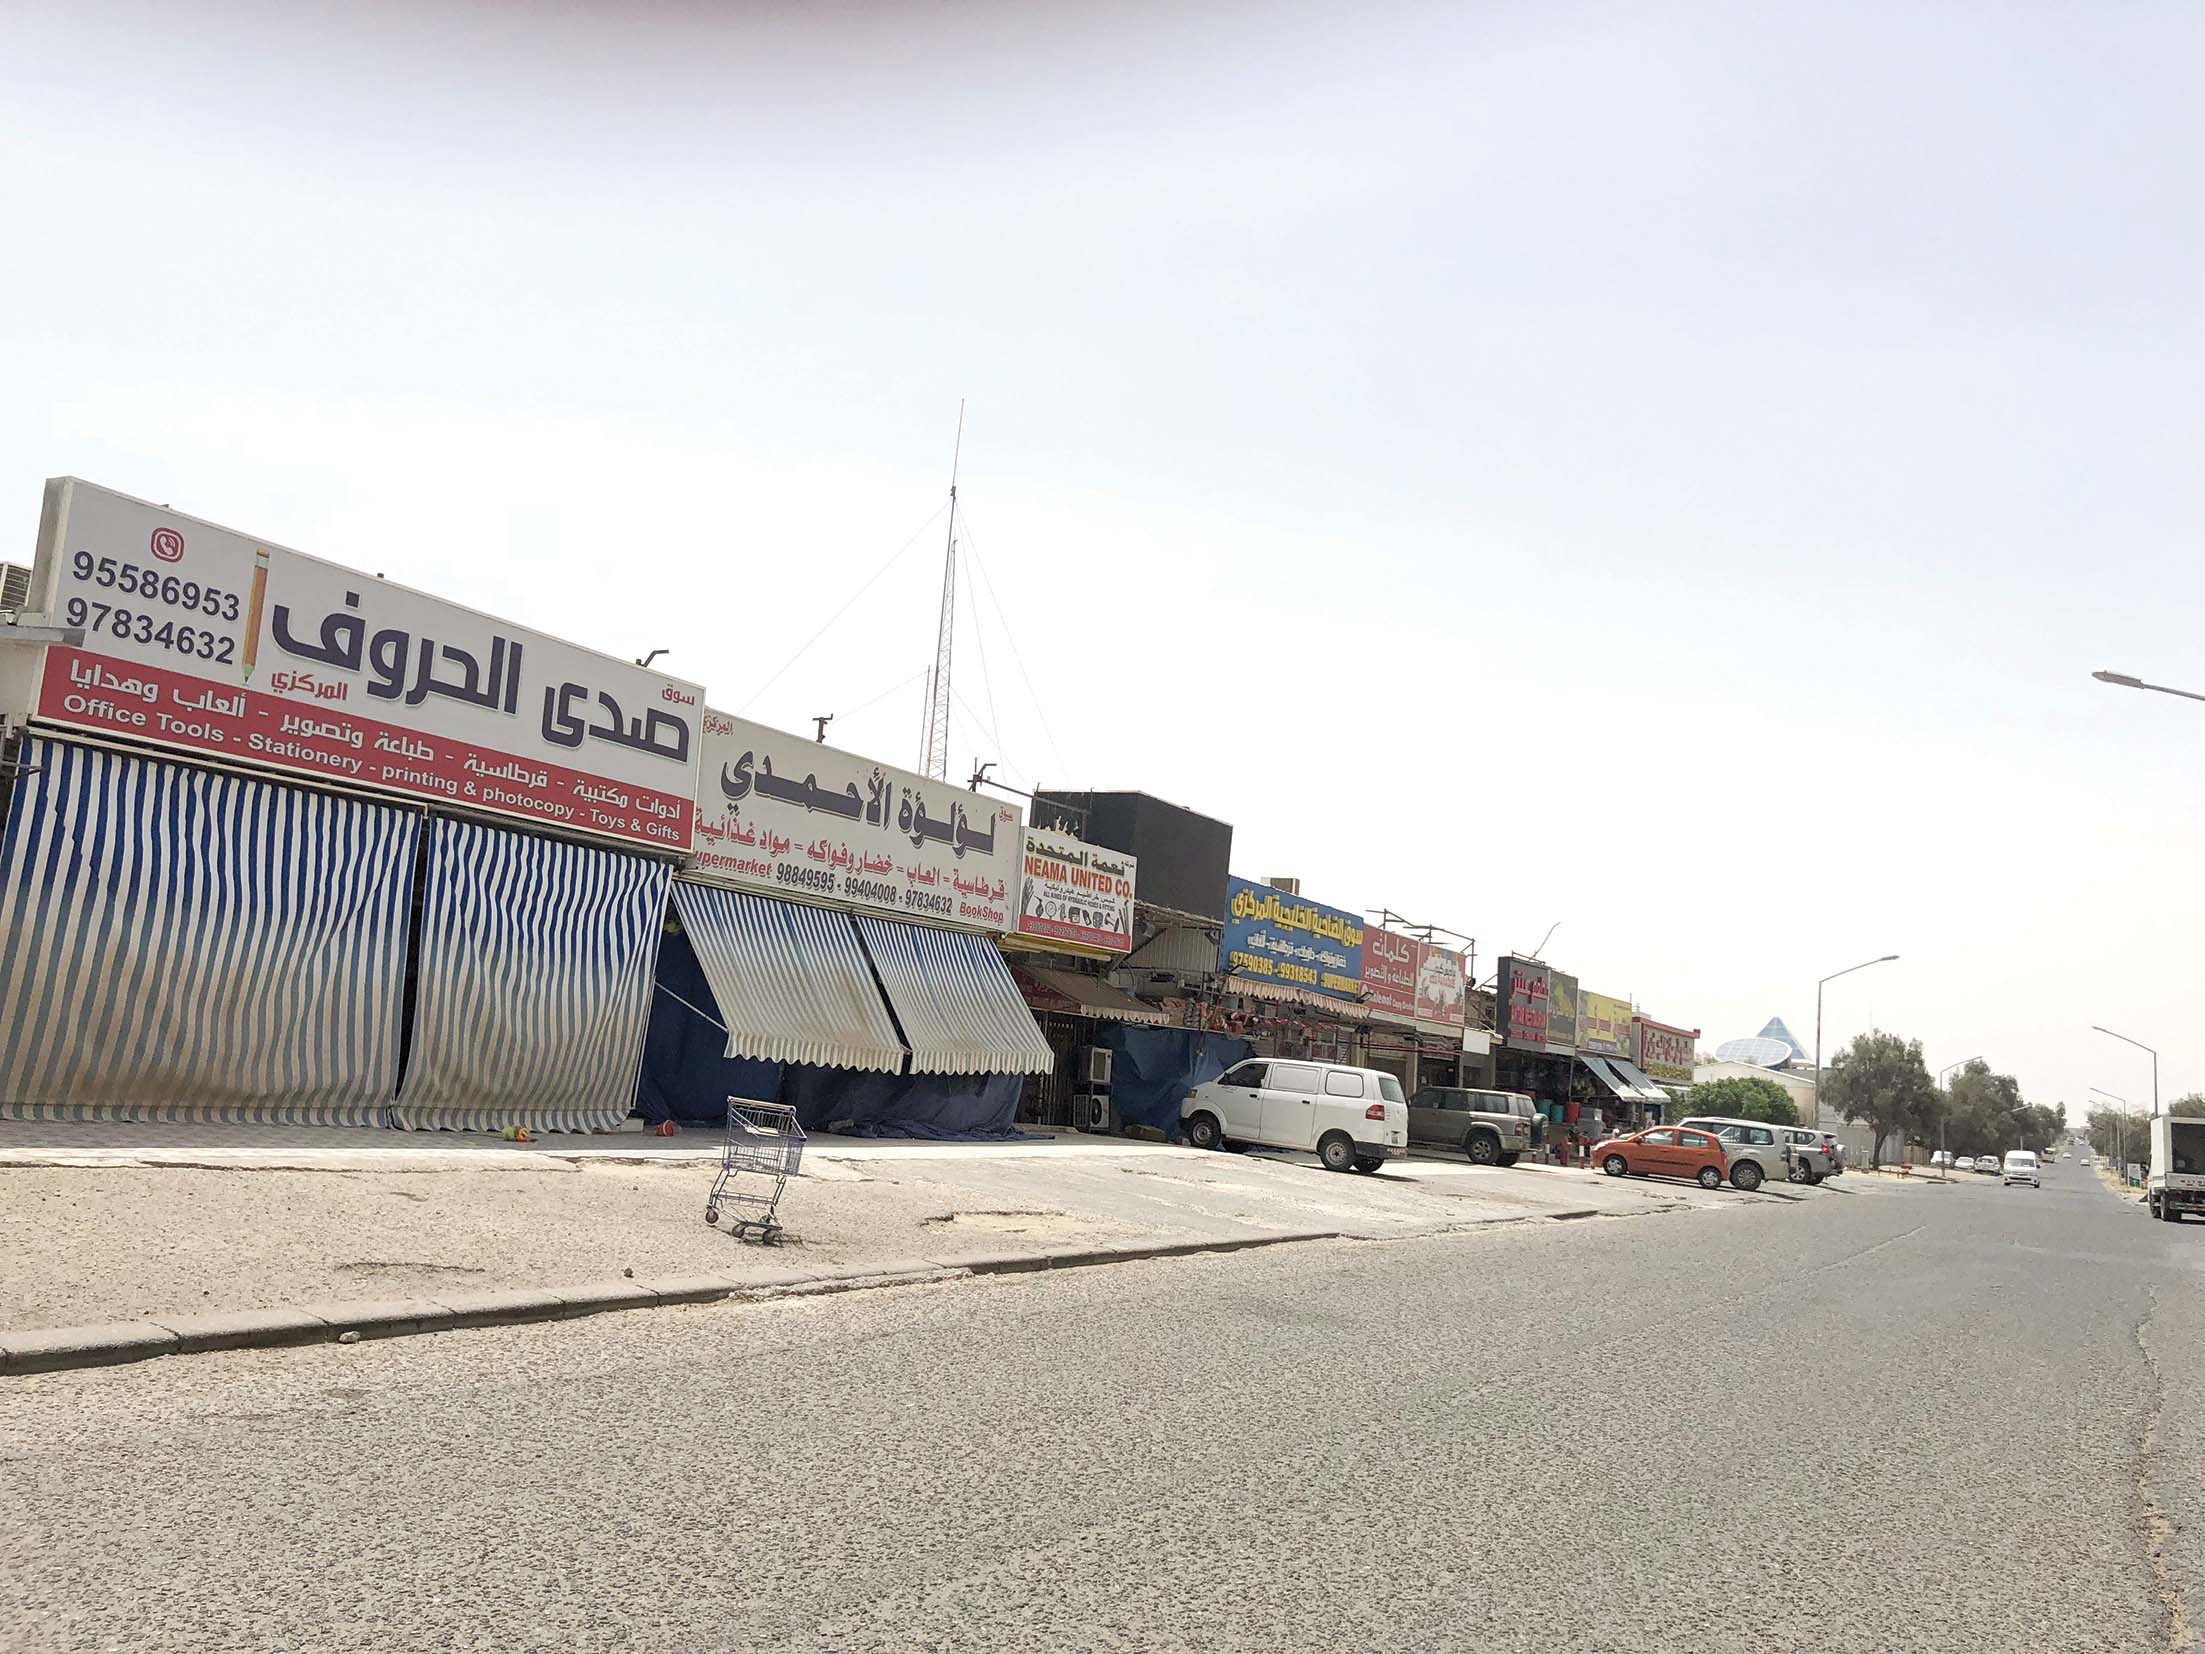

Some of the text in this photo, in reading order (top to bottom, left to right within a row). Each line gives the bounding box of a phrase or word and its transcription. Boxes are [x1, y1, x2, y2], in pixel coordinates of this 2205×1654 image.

[72, 550, 240, 622] 95586953
[66, 597, 236, 665] 97834632
[69, 658, 160, 703] وهدايا
[271, 671, 349, 701] المركزي
[272, 591, 689, 764] صدى الحروف
[661, 684, 696, 706] سوق
[172, 688, 247, 719] ألعاب
[280, 714, 365, 749] وتصوير
[702, 714, 734, 737] المركز
[374, 732, 435, 762] طباعة
[63, 694, 147, 727] Office
[156, 712, 225, 743] Tools
[248, 732, 364, 775] Stationery
[382, 764, 458, 796] printing
[463, 781, 477, 796] &
[483, 784, 574, 820] photocopy
[590, 808, 626, 832] Toys
[631, 819, 641, 832] &
[646, 822, 680, 842] Gifts
[463, 752, 548, 789] قرطاسية
[572, 778, 629, 809] مكتبية
[635, 792, 681, 820] أدوات
[1025, 836, 1089, 867] المتحدة
[694, 850, 1005, 926] upermarket 98849595 99404008 97834632 BookShop
[1024, 855, 1134, 899] NEAMA UNITED CO.
